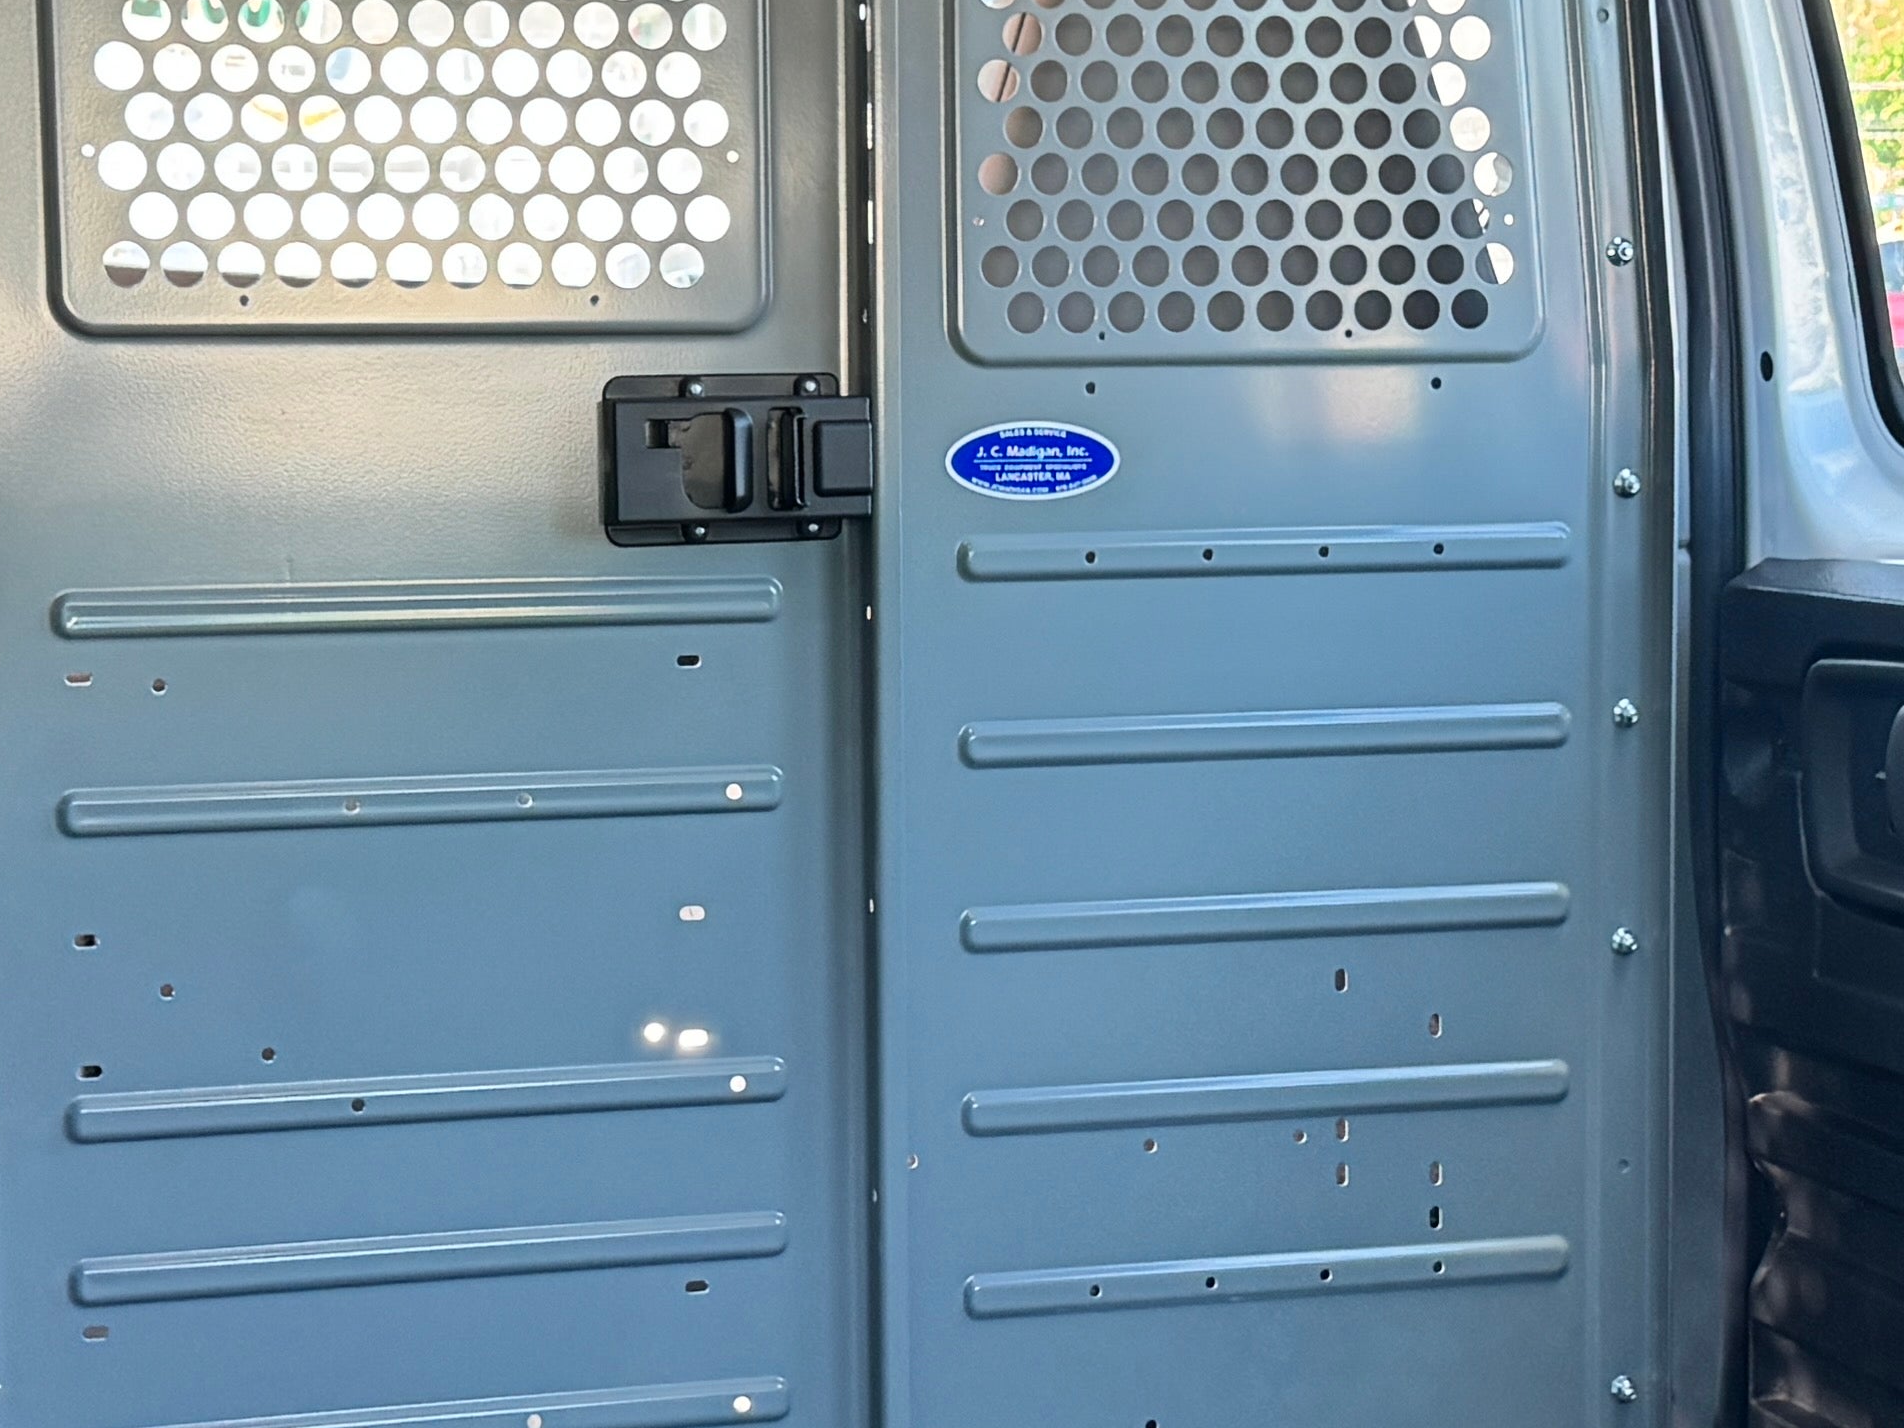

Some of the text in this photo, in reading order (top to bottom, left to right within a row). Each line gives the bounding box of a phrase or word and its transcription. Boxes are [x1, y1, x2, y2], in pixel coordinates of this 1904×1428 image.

[977, 445, 1089, 460] J. C. Madigan, Inc.
[995, 471, 1055, 482] LANCASTER,
